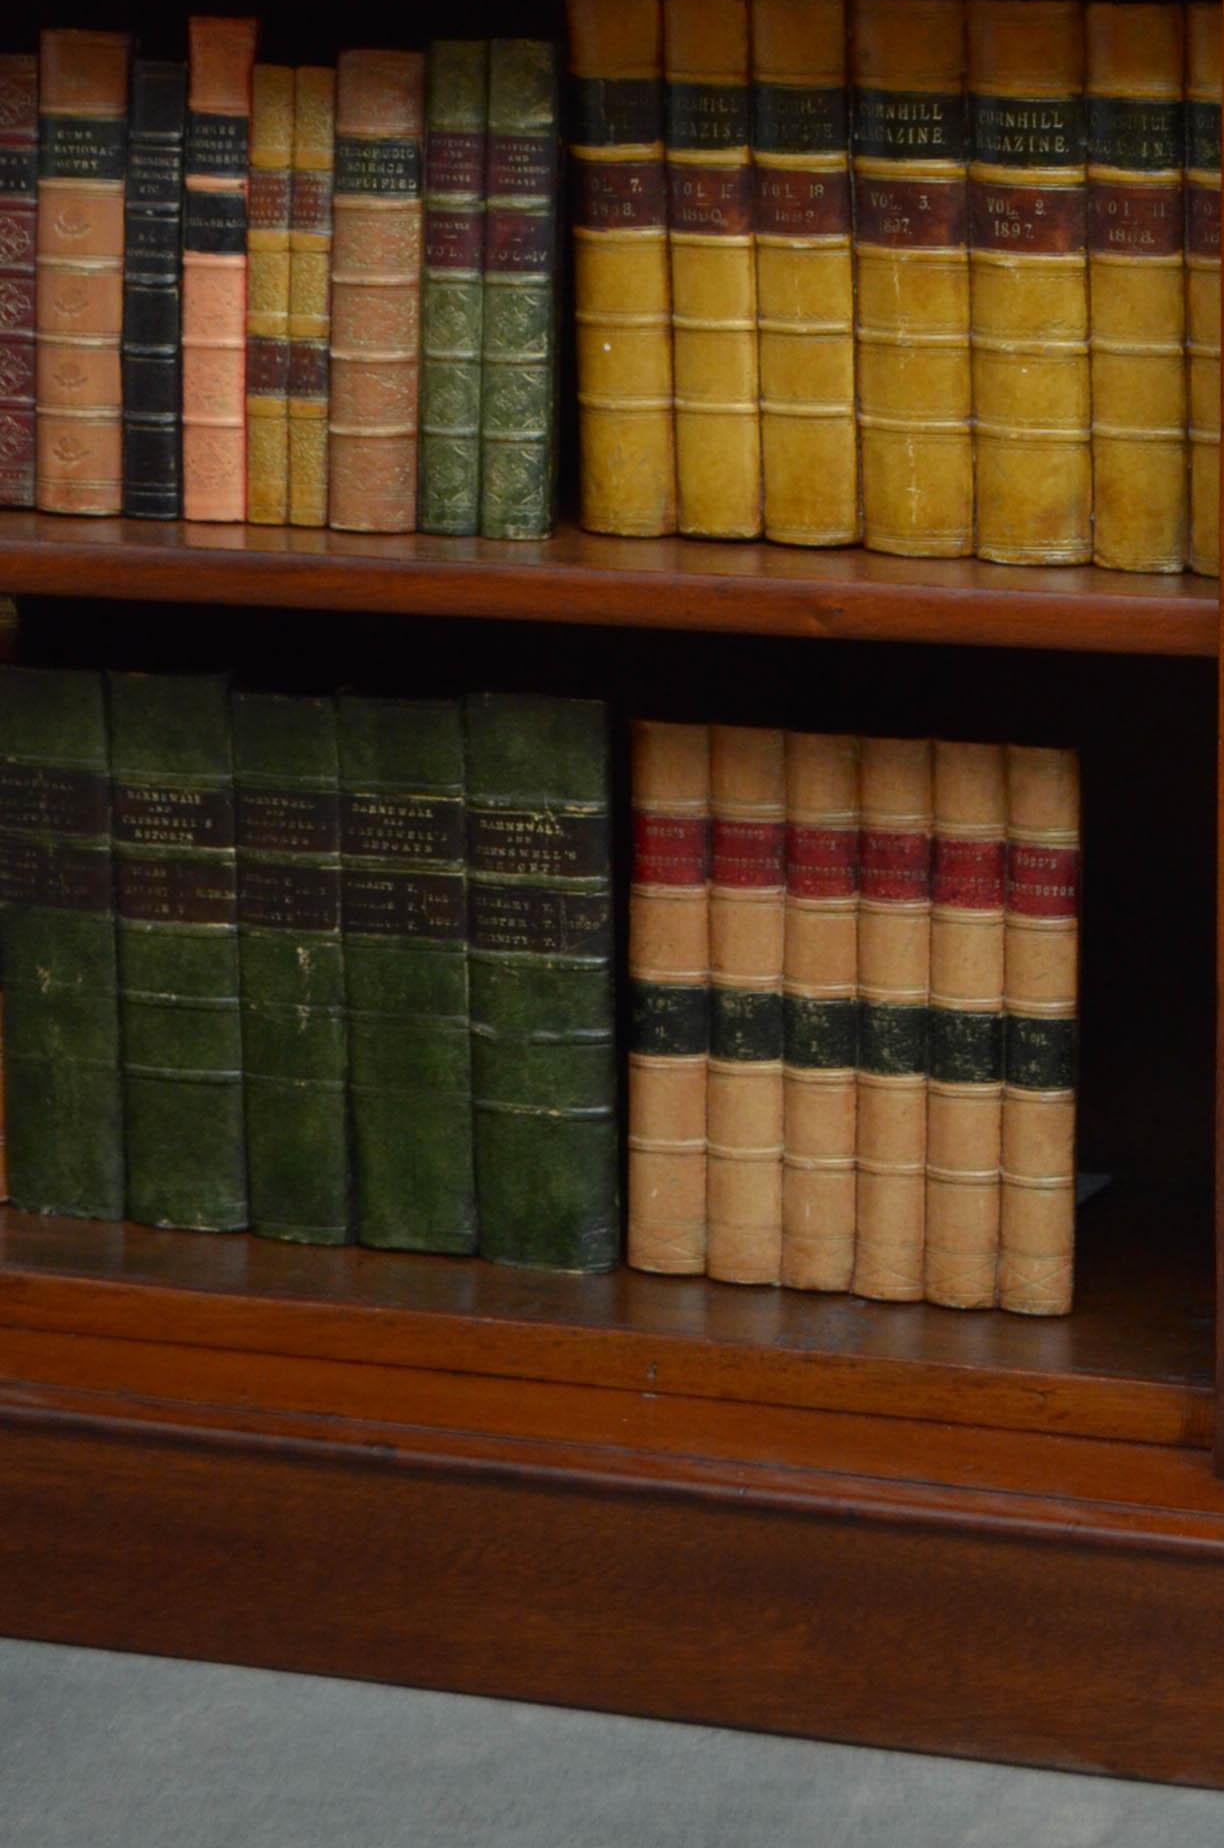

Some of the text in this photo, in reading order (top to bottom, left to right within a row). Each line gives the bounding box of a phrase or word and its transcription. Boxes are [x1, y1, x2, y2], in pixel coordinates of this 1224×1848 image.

[918, 194, 932, 210] 3.
[985, 196, 1047, 216] VOL. 2.
[993, 220, 1035, 239] 1897.
